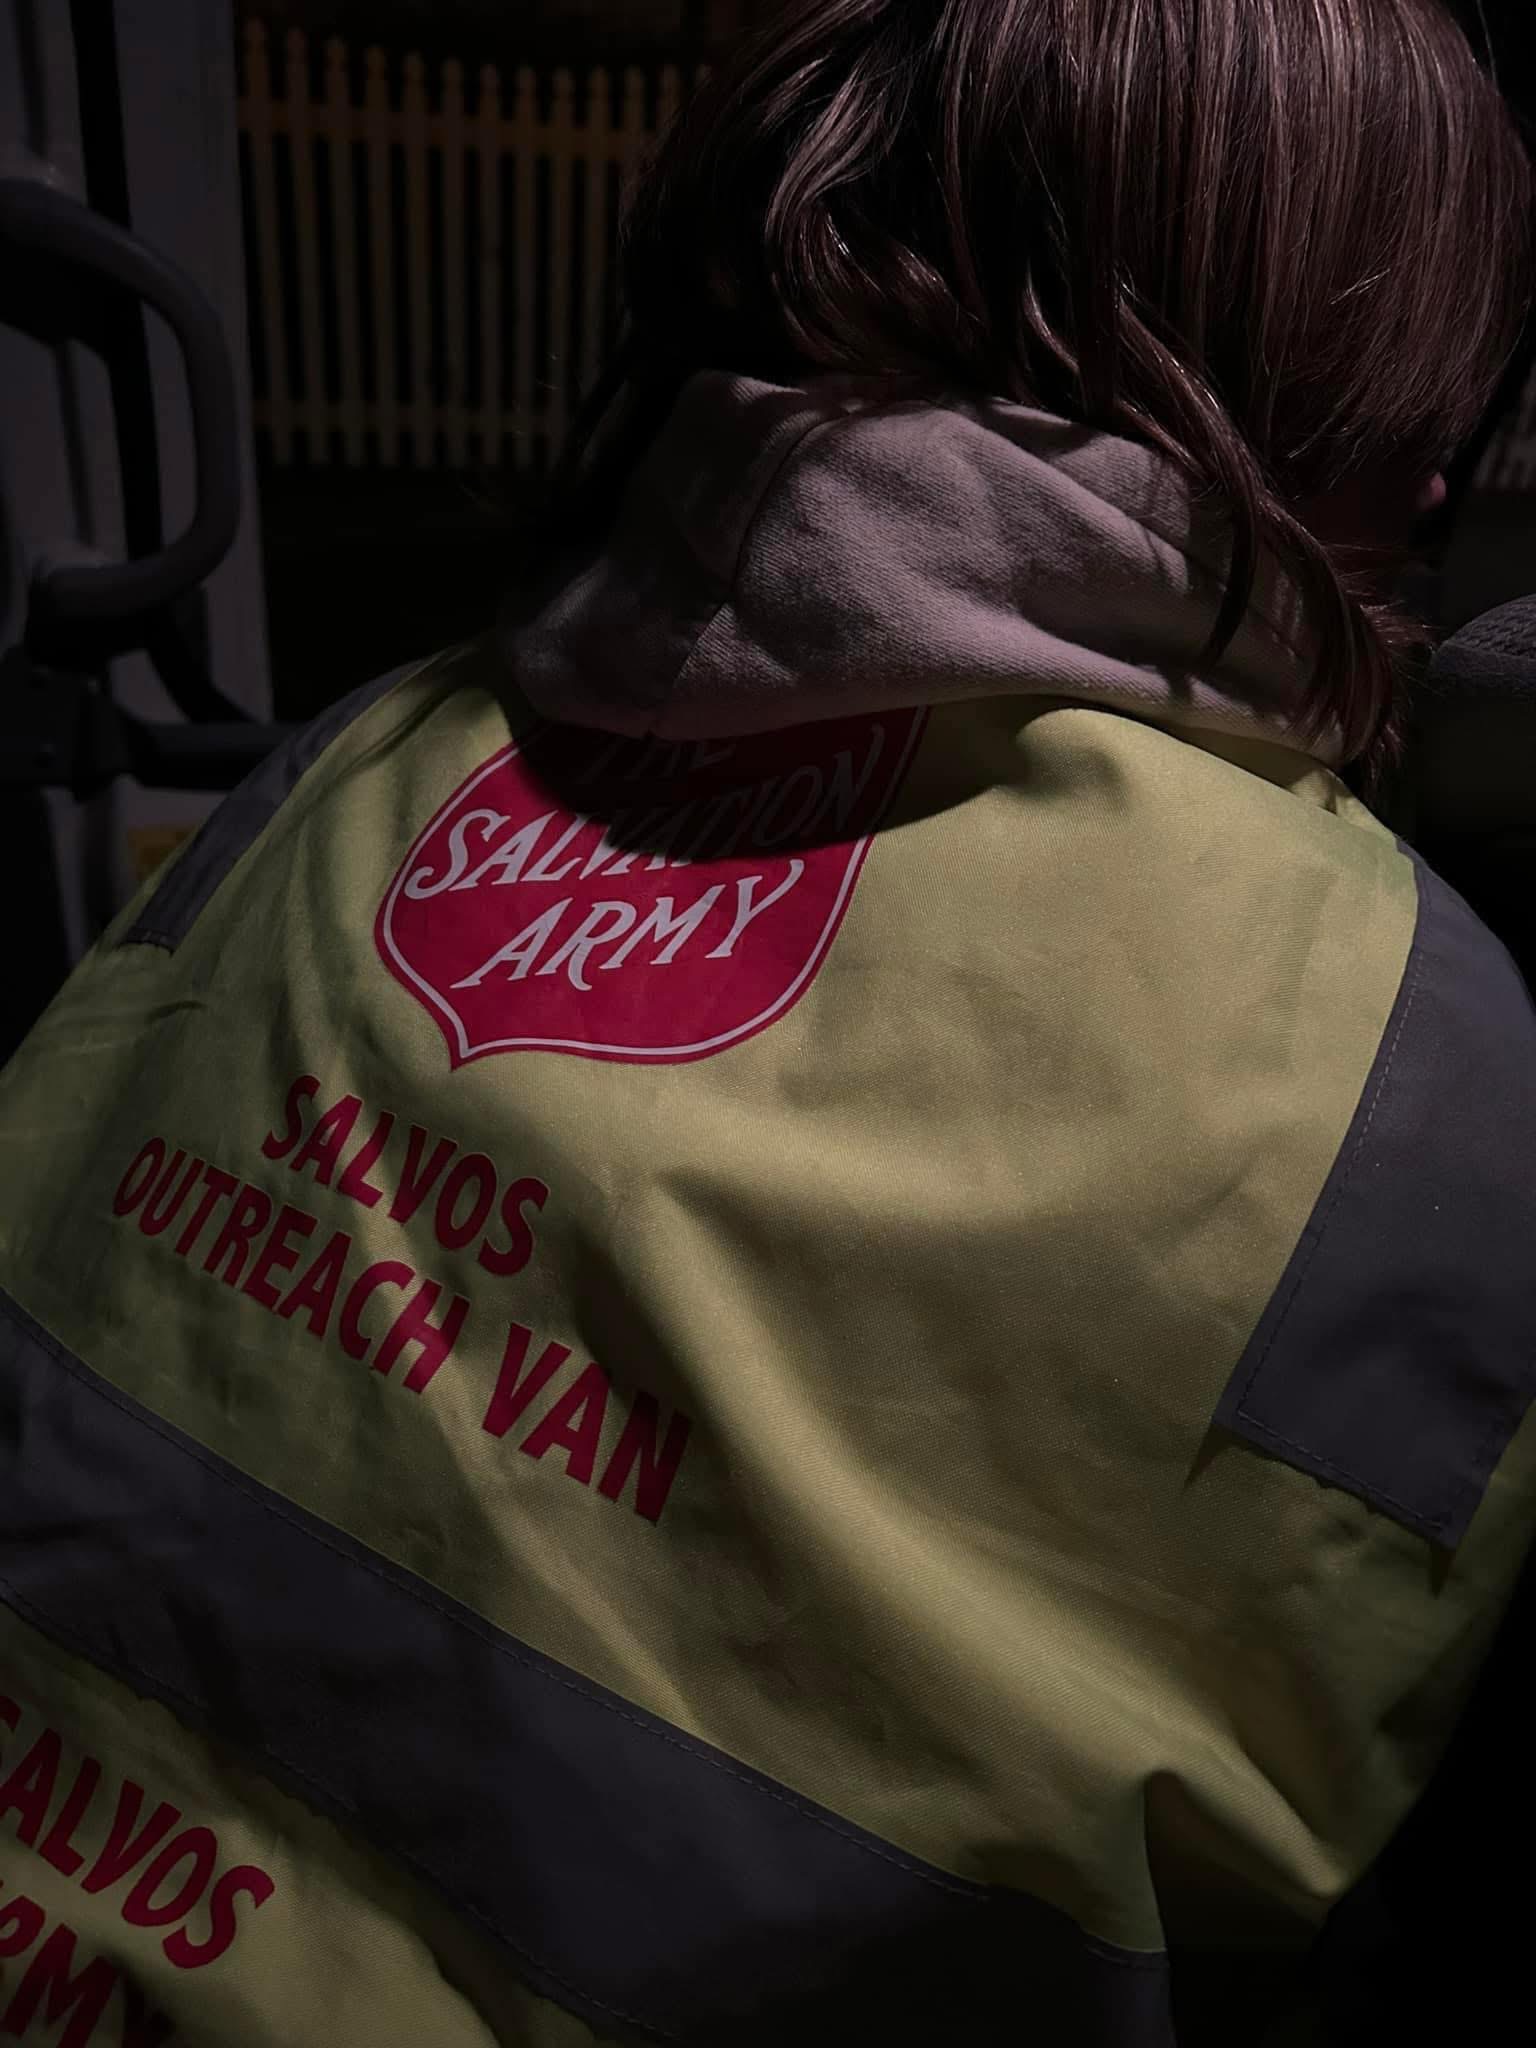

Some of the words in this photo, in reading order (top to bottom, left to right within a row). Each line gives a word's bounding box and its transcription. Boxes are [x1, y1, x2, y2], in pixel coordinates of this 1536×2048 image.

[404, 721, 885, 900] SALVATION
[449, 858, 805, 991] ARMY
[261, 1075, 548, 1275] SALVOS
[112, 1136, 470, 1395] OUTREACH
[482, 1322, 692, 1525] VAN
[0, 1695, 275, 1969] ALVOS
